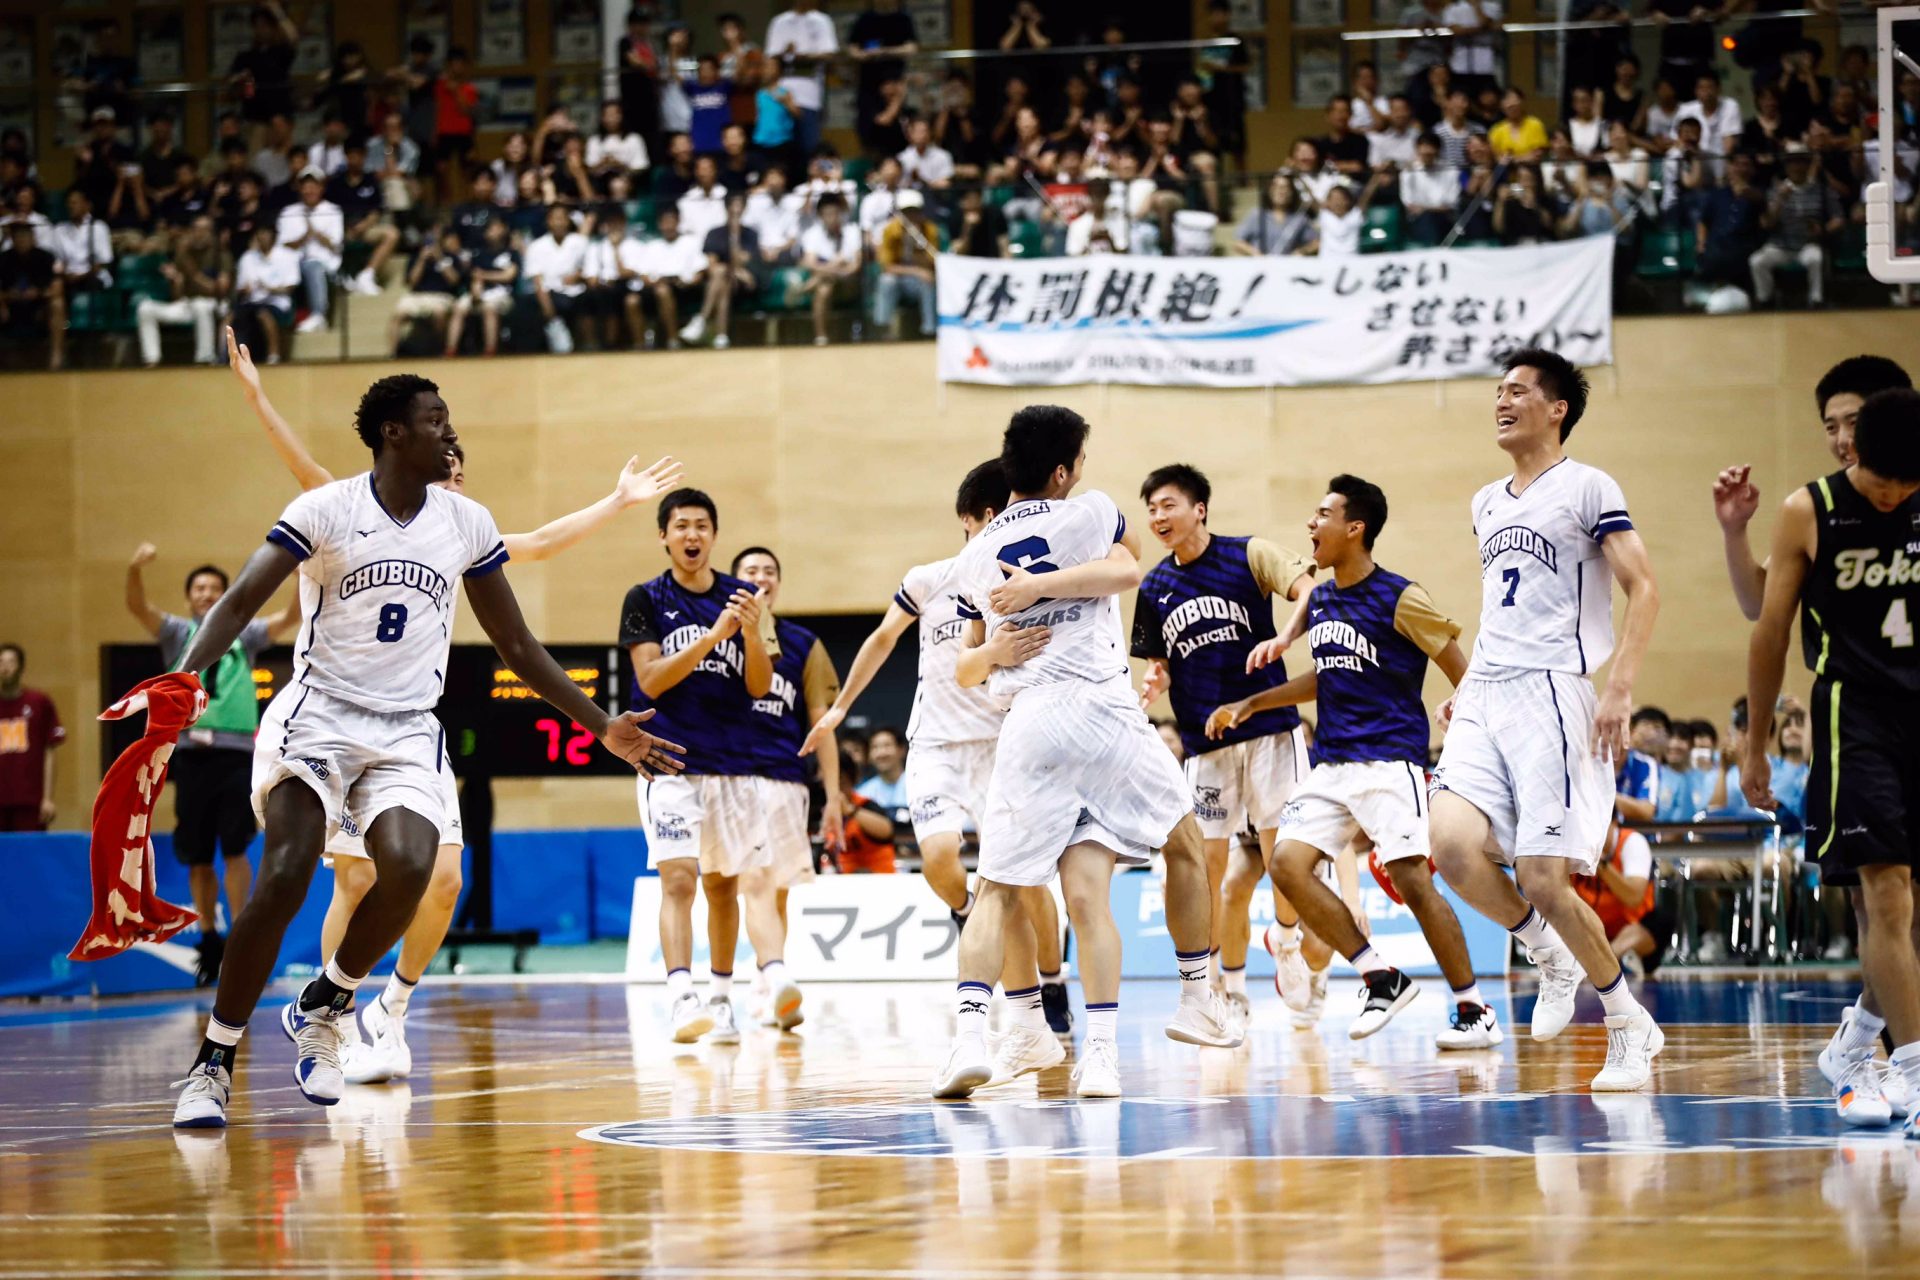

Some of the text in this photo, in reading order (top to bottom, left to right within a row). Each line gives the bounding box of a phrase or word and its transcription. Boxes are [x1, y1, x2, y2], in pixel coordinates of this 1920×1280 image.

[1366, 298, 1526, 331] させない
[1481, 525, 1557, 579] HUBUDAI
[1501, 567, 1520, 607] 7
[376, 603, 408, 642] 8
[1176, 623, 1240, 660] DAIICHI
[1881, 598, 1914, 648] 4
[534, 718, 596, 766] 72
